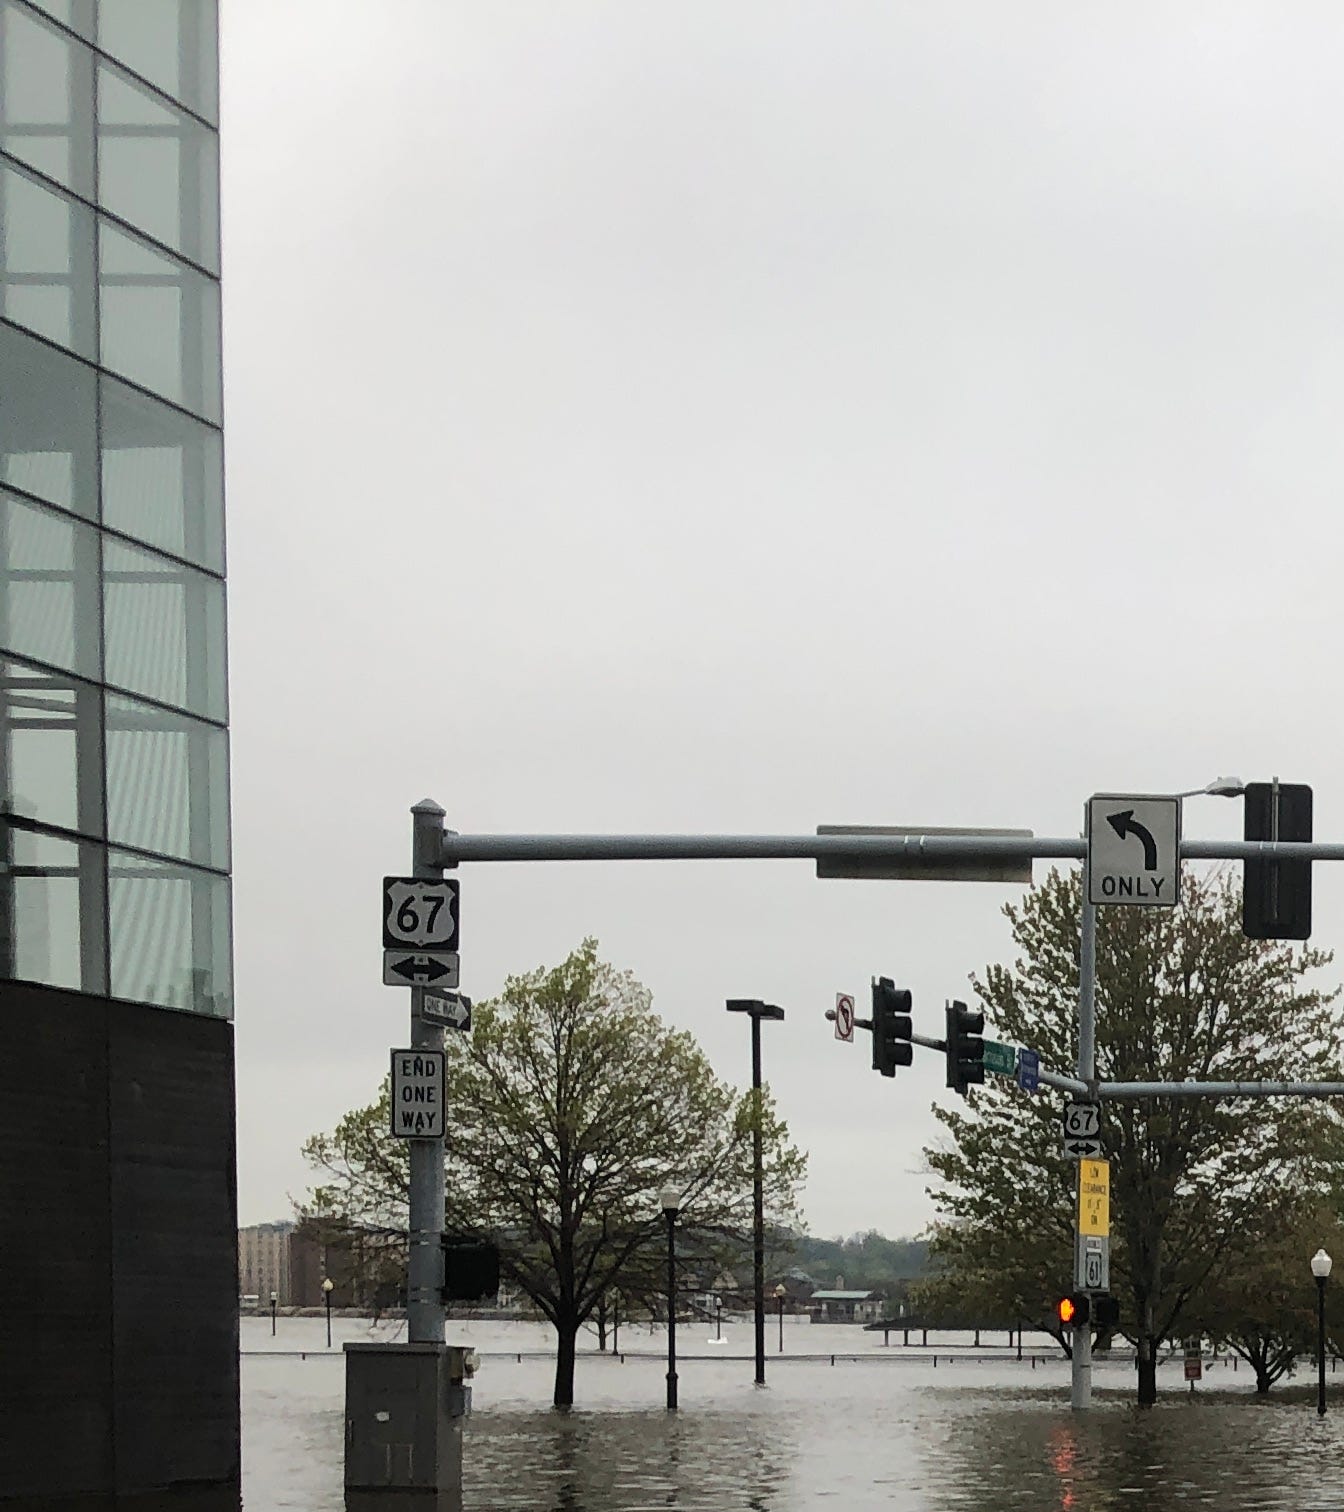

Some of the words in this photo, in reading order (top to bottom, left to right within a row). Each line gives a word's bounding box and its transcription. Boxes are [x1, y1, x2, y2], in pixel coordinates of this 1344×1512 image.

[1102, 875, 1165, 897] ONLY
[397, 895, 445, 934] 67
[426, 997, 440, 1013] ONE
[443, 1001, 458, 1018] WAY
[402, 1060, 435, 1078] END
[402, 1086, 436, 1103] ONE
[402, 1111, 436, 1129] WAY
[1069, 1110, 1094, 1131] 67
[1089, 1261, 1099, 1281] 61
